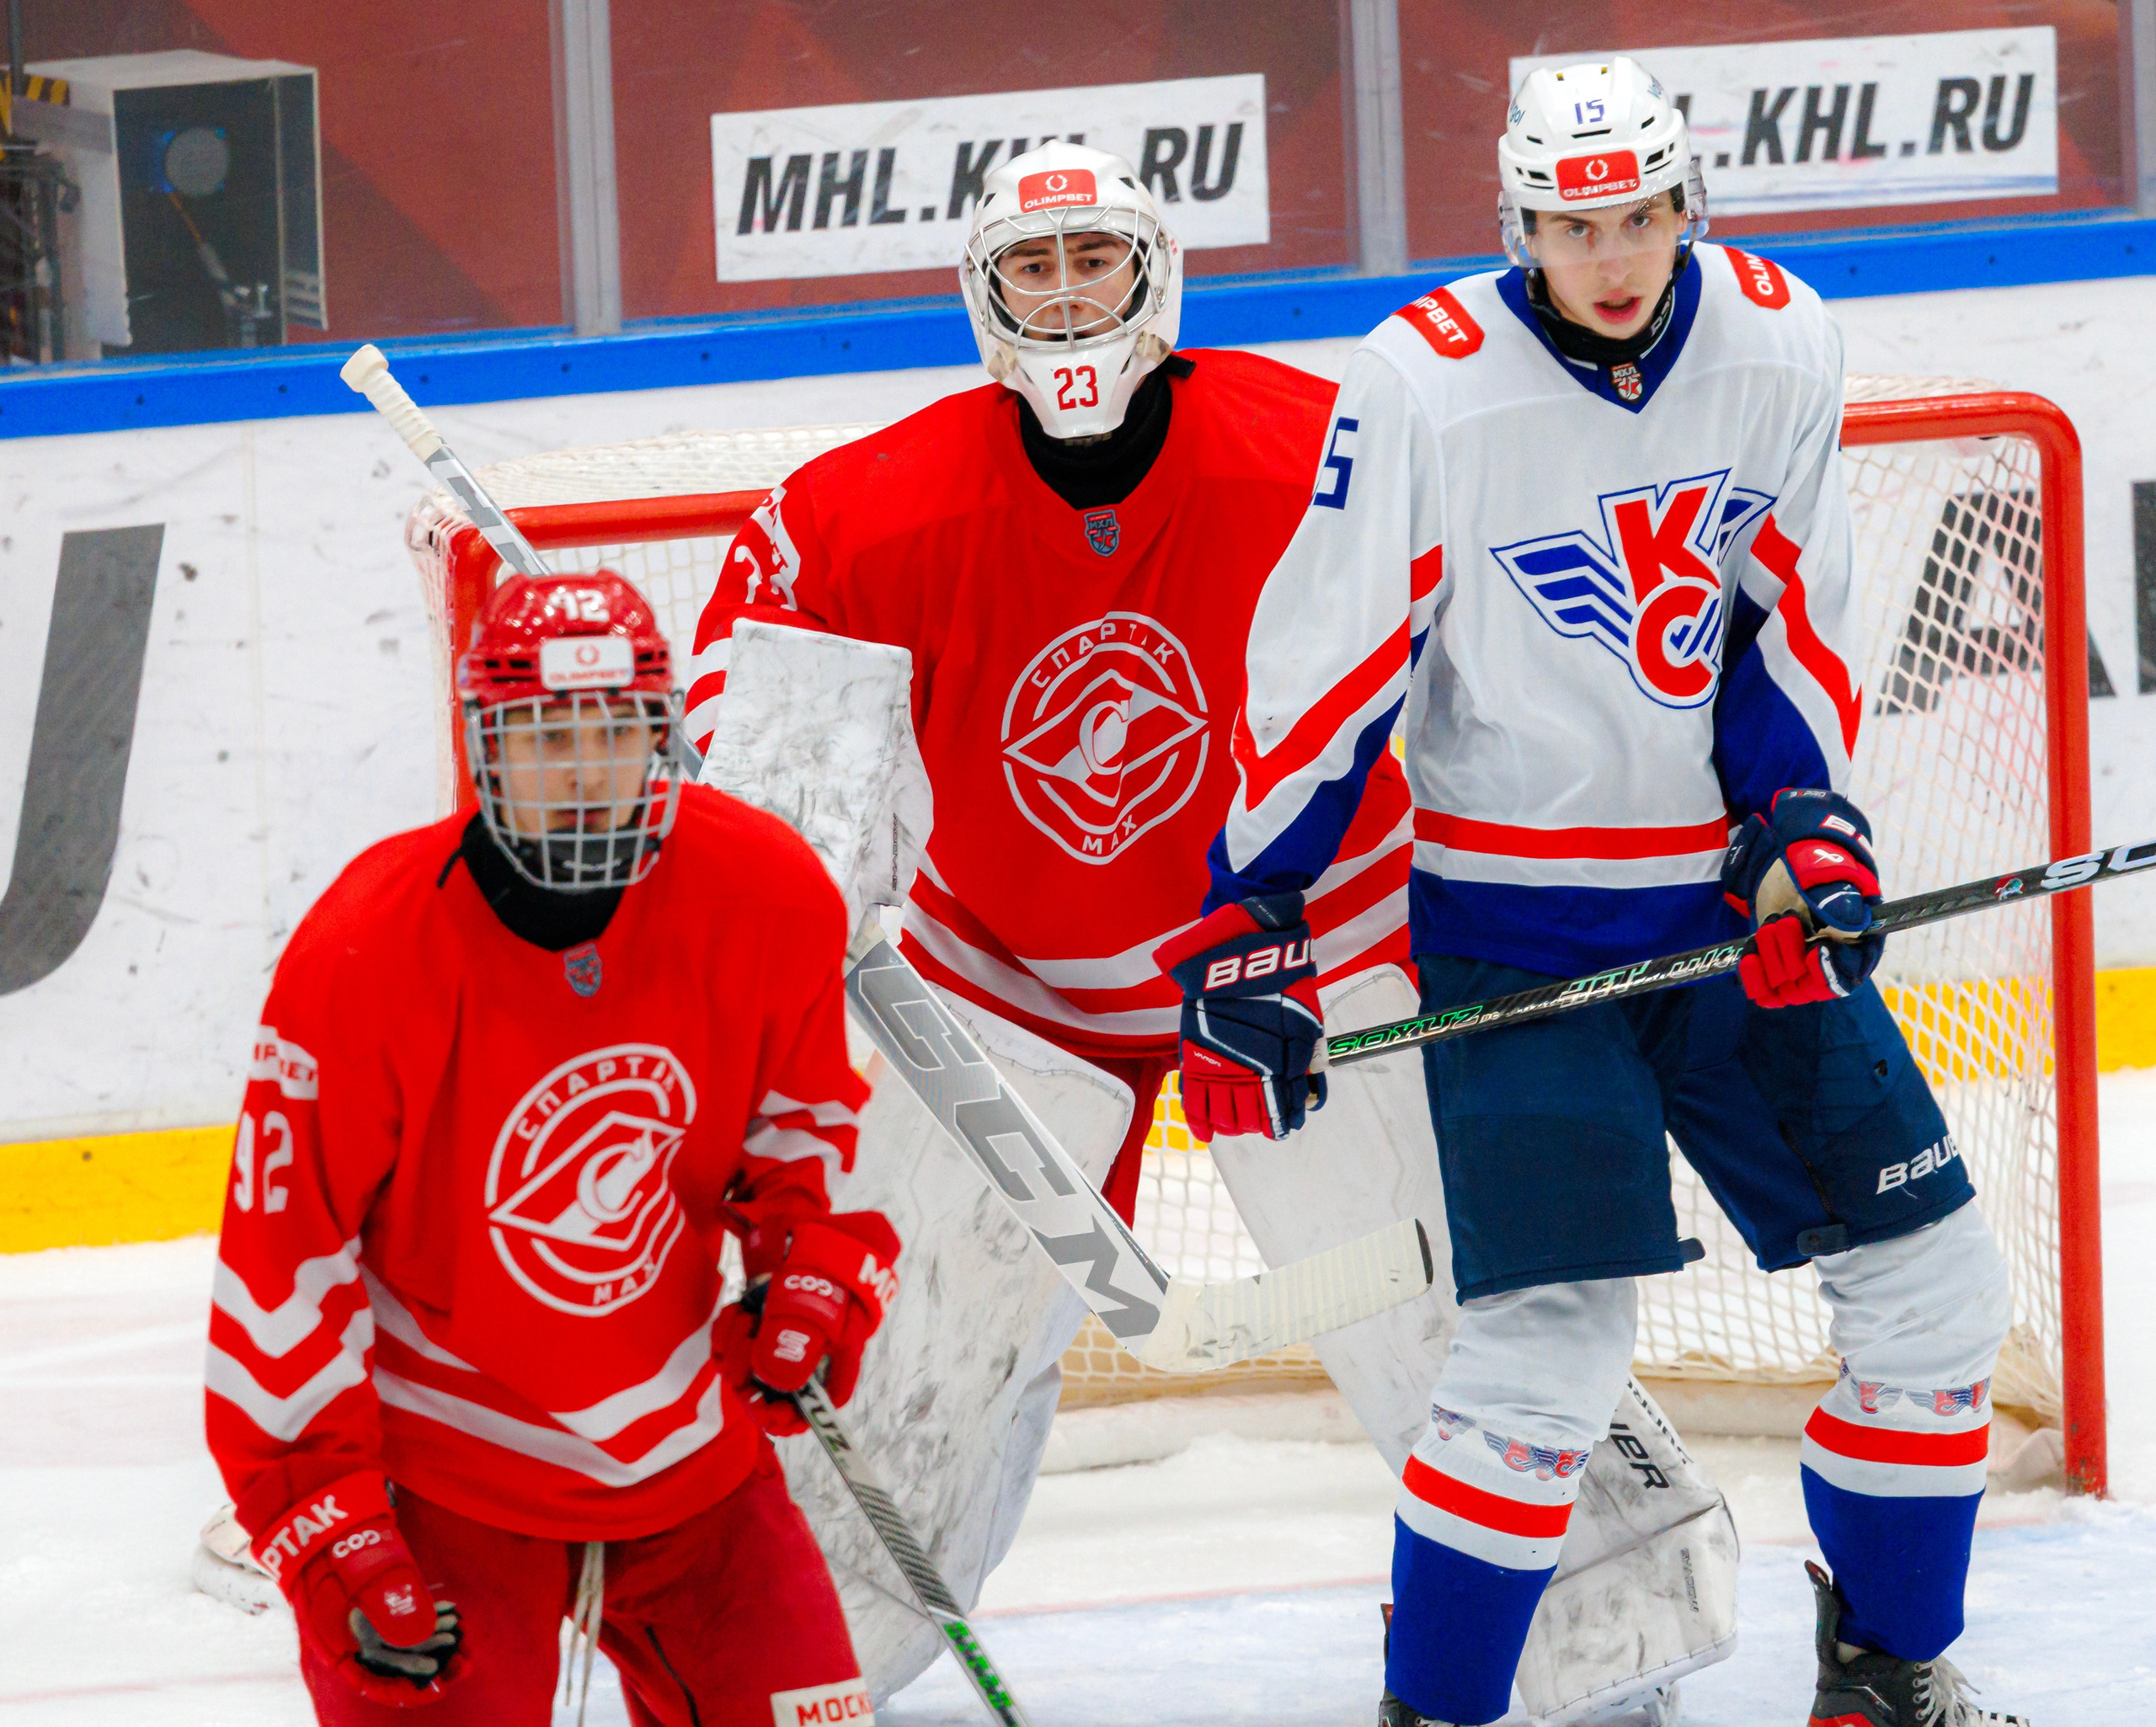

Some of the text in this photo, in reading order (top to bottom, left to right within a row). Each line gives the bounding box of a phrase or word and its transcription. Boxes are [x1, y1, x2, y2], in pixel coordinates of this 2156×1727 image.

[1574, 99, 1606, 125] 15
[1024, 193, 1093, 209] OLIMPBET
[1563, 179, 1637, 199] OLIMPBET
[1053, 364, 1099, 411] 23
[1030, 622, 1176, 689] СПАРТК
[1327, 1005, 1483, 1054] SOYUZ
[233, 1110, 294, 1215] 92
[858, 964, 1161, 1339] CCM
